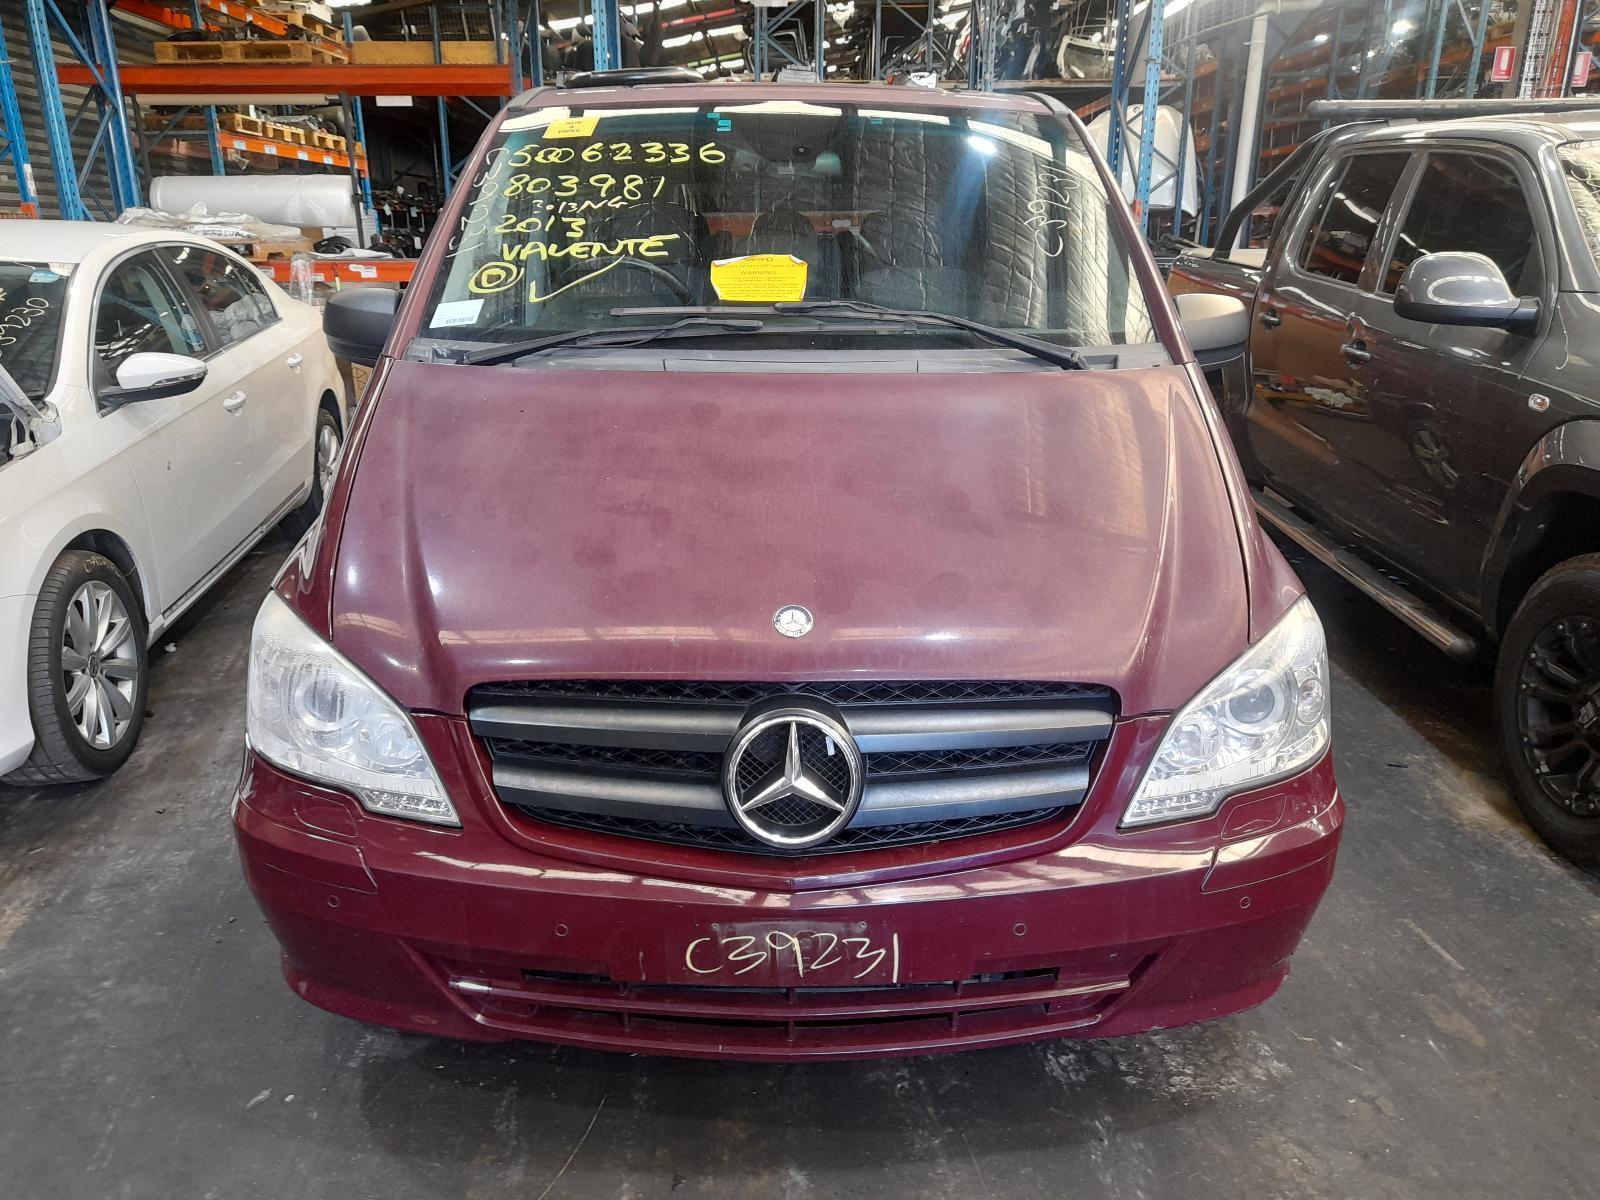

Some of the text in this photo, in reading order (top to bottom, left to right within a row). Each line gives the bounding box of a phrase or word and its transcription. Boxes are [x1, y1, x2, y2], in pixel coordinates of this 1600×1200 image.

[495, 214, 586, 238] 2013
[502, 233, 681, 261] VALENTE
[685, 930, 899, 983] C39231
